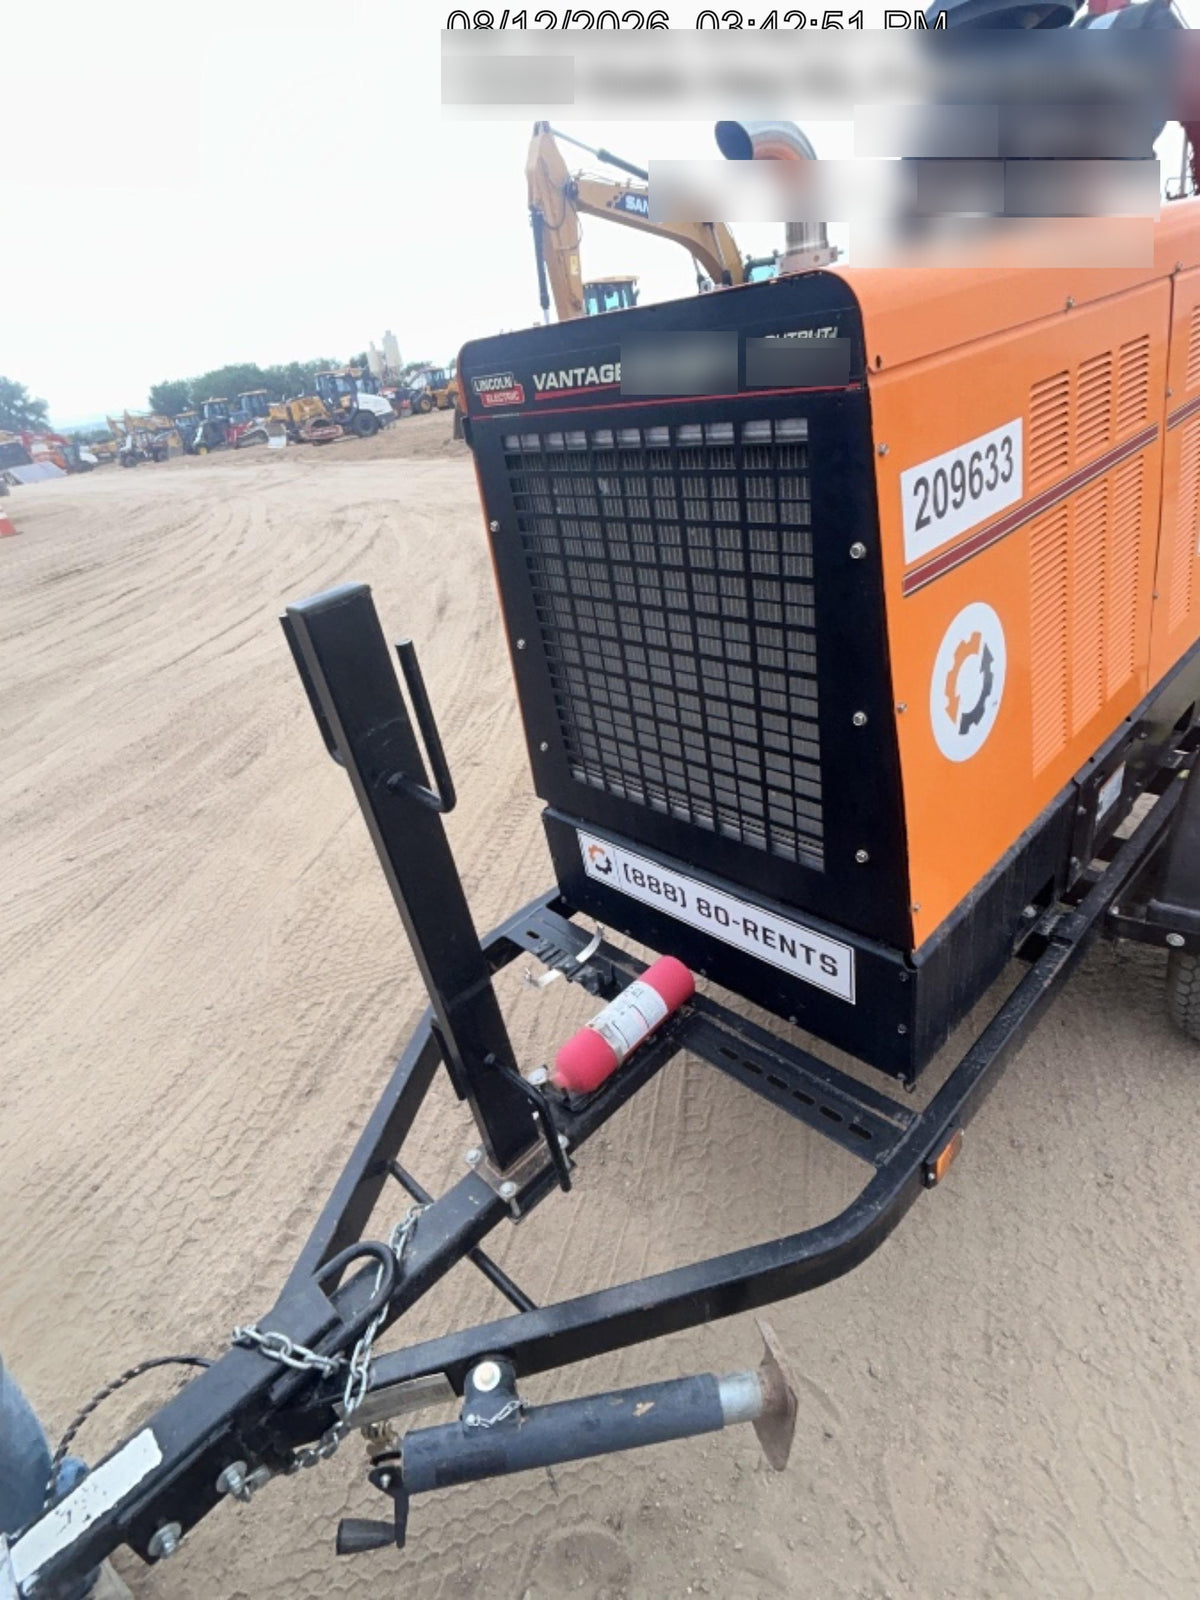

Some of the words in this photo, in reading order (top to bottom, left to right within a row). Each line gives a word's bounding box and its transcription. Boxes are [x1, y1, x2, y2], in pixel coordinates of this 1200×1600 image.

[474, 375, 513, 393] LINCOLN
[913, 435, 1013, 532] 209633
[623, 863, 687, 908] (888)
[696, 897, 839, 978] 80-RENTS
